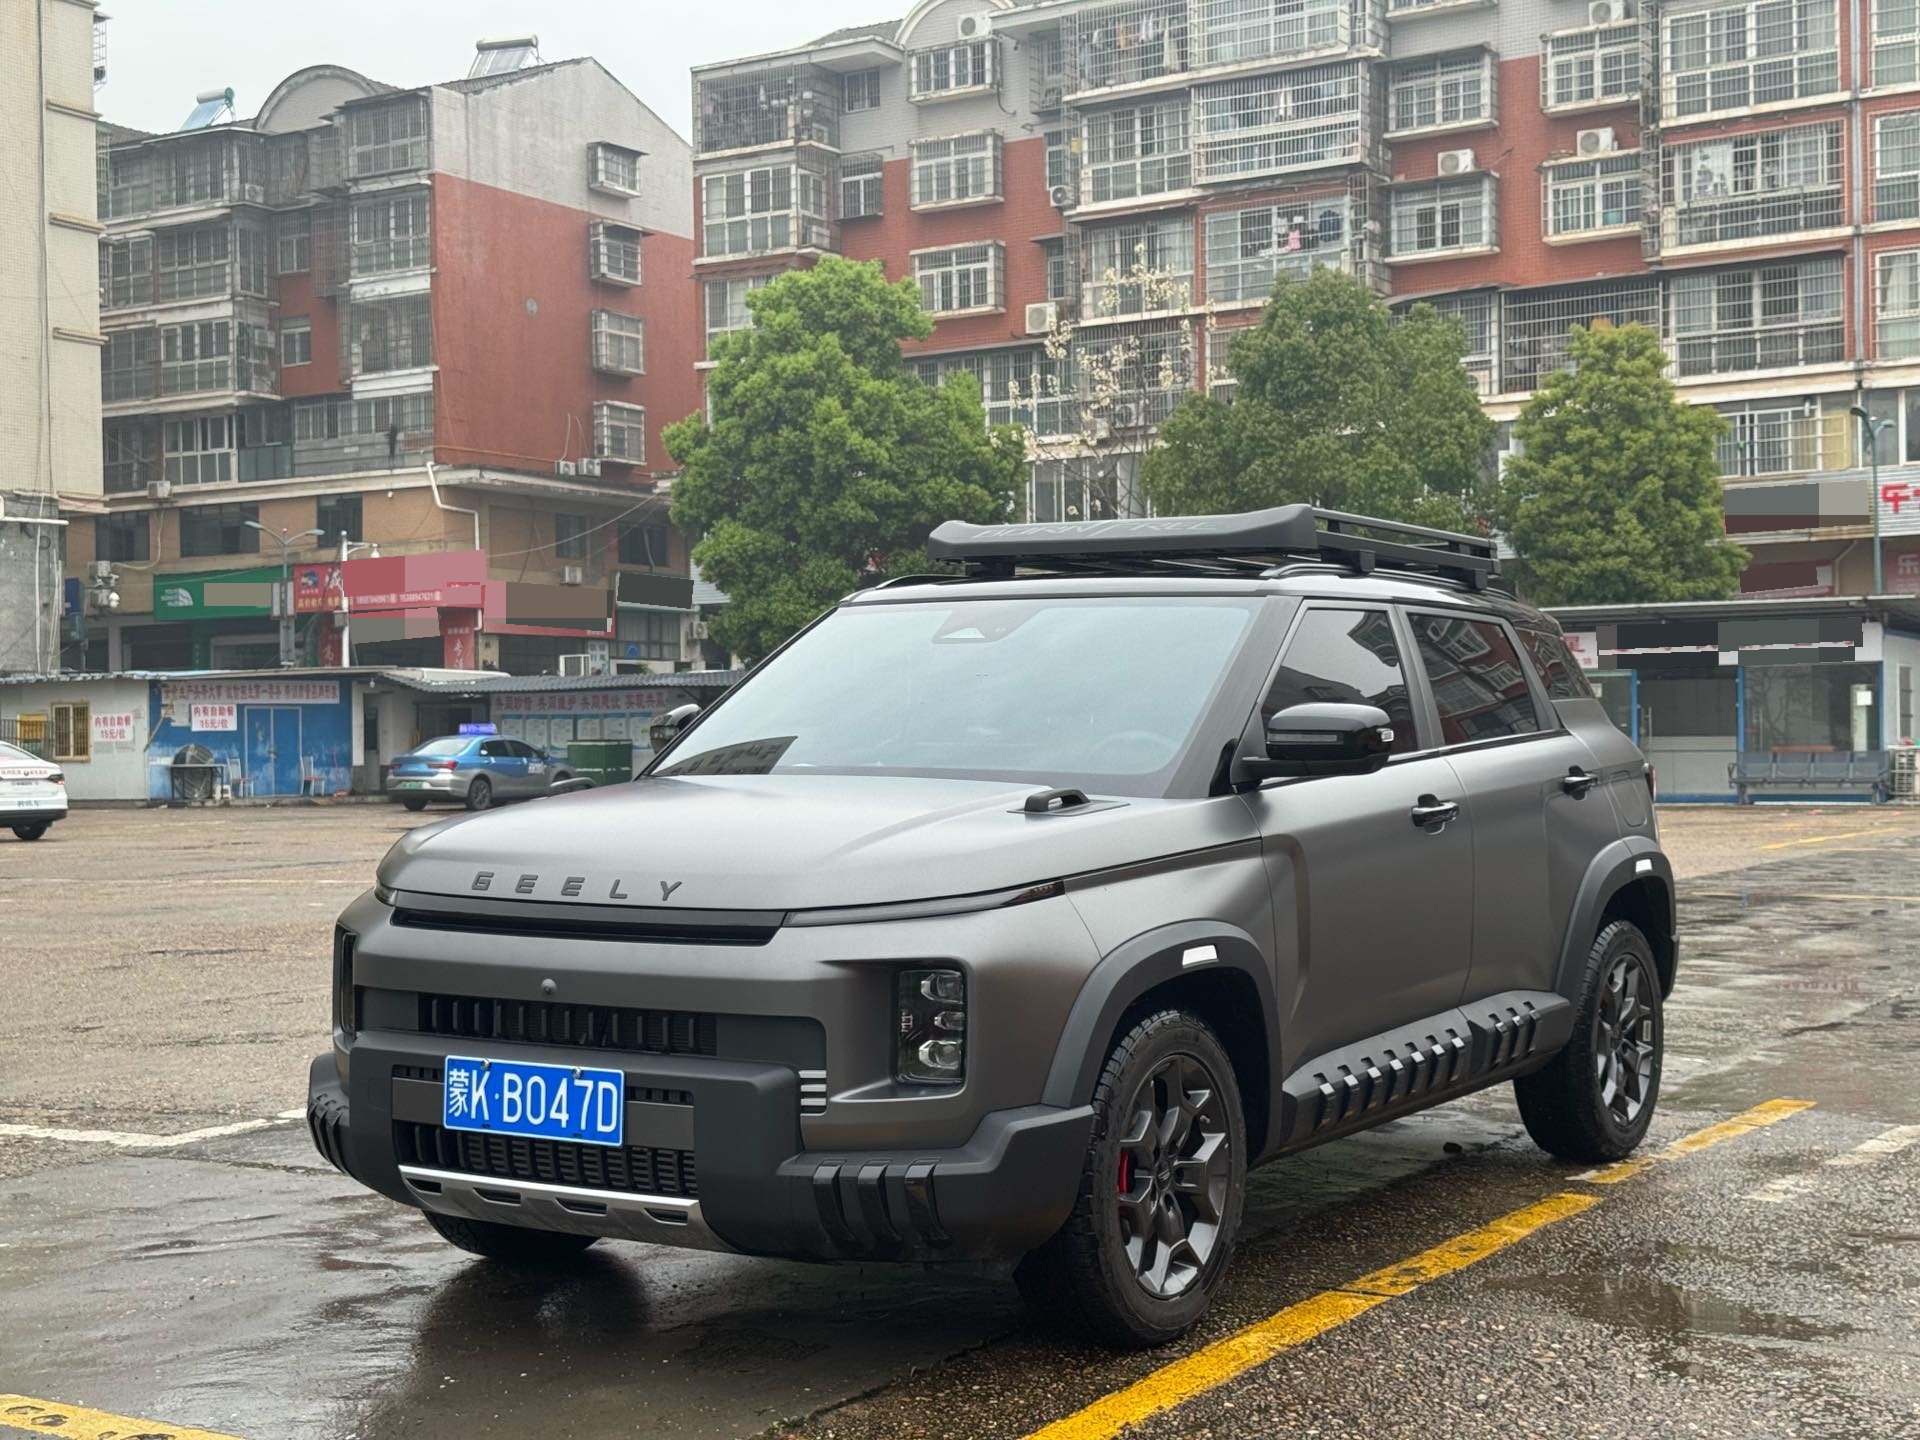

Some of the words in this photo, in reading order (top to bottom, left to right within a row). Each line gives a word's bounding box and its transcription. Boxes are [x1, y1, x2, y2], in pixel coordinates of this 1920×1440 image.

[194, 705, 234, 717] 内有自助餐
[94, 714, 131, 728] 内有自助餐
[471, 871, 683, 902] GEELY
